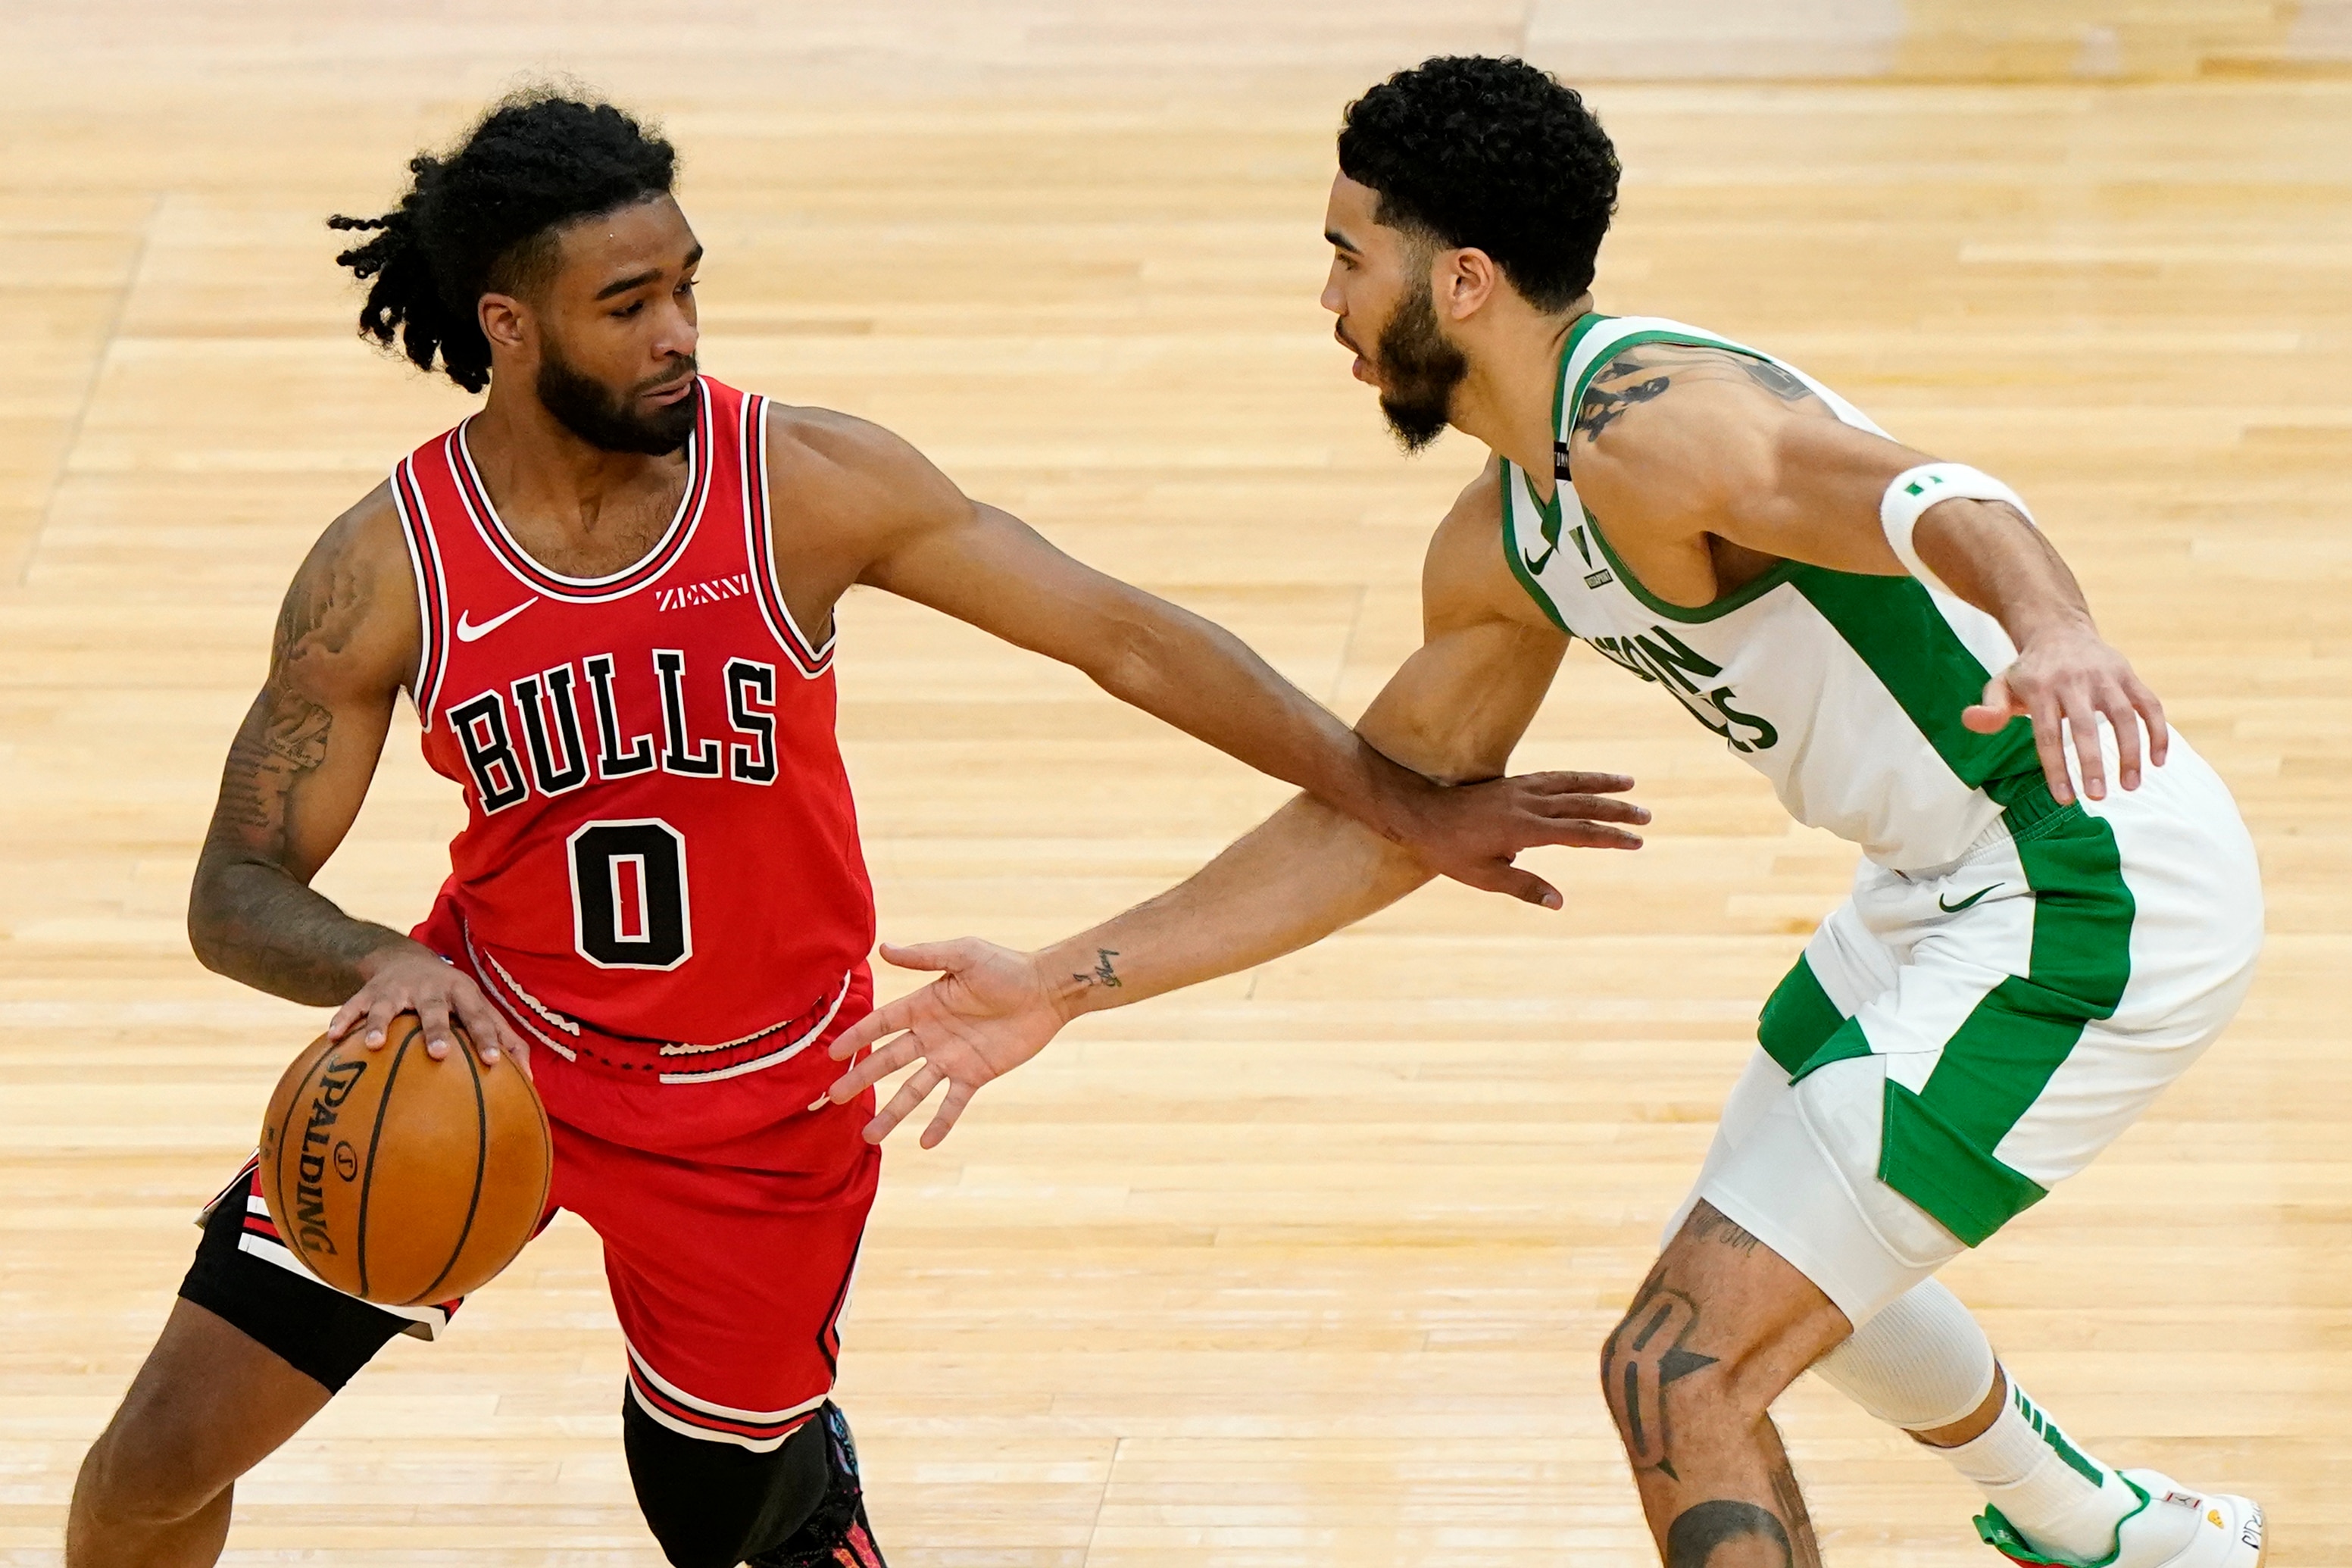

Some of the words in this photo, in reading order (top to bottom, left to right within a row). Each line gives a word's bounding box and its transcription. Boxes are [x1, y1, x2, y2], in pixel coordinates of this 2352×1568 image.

[655, 573, 750, 612] ZENNI
[445, 648, 779, 817] BULLS
[566, 817, 693, 971] 0
[296, 1054, 368, 1257] SPALDING
